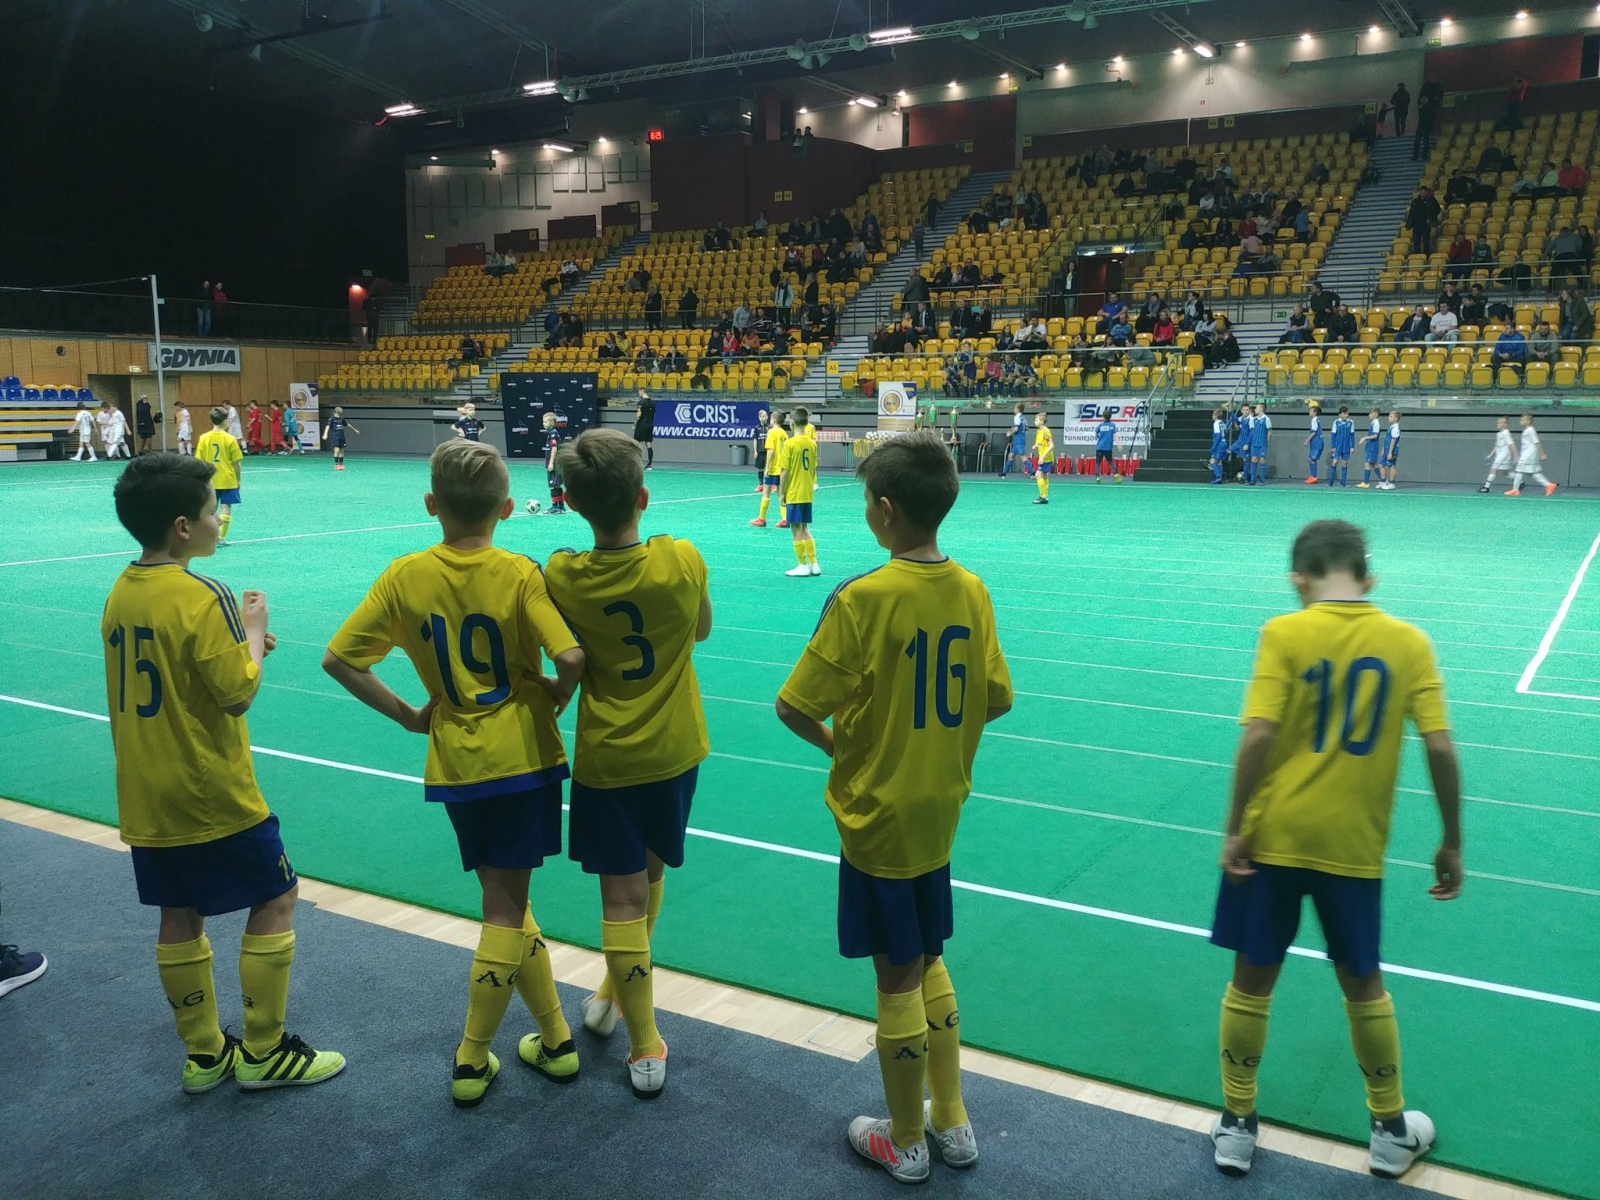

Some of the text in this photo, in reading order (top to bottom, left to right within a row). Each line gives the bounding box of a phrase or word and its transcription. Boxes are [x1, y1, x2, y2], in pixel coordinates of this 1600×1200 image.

[156, 348, 236, 368] GDYNIA
[652, 426, 755, 438] WWW.CRIST.COM.P
[693, 404, 736, 423] CRIST
[212, 443, 220, 463] 2
[802, 448, 810, 471] 6
[420, 612, 512, 707] 19
[603, 600, 655, 681] 3
[108, 624, 162, 718] 15
[905, 625, 971, 729] 16
[1301, 656, 1391, 757] 10
